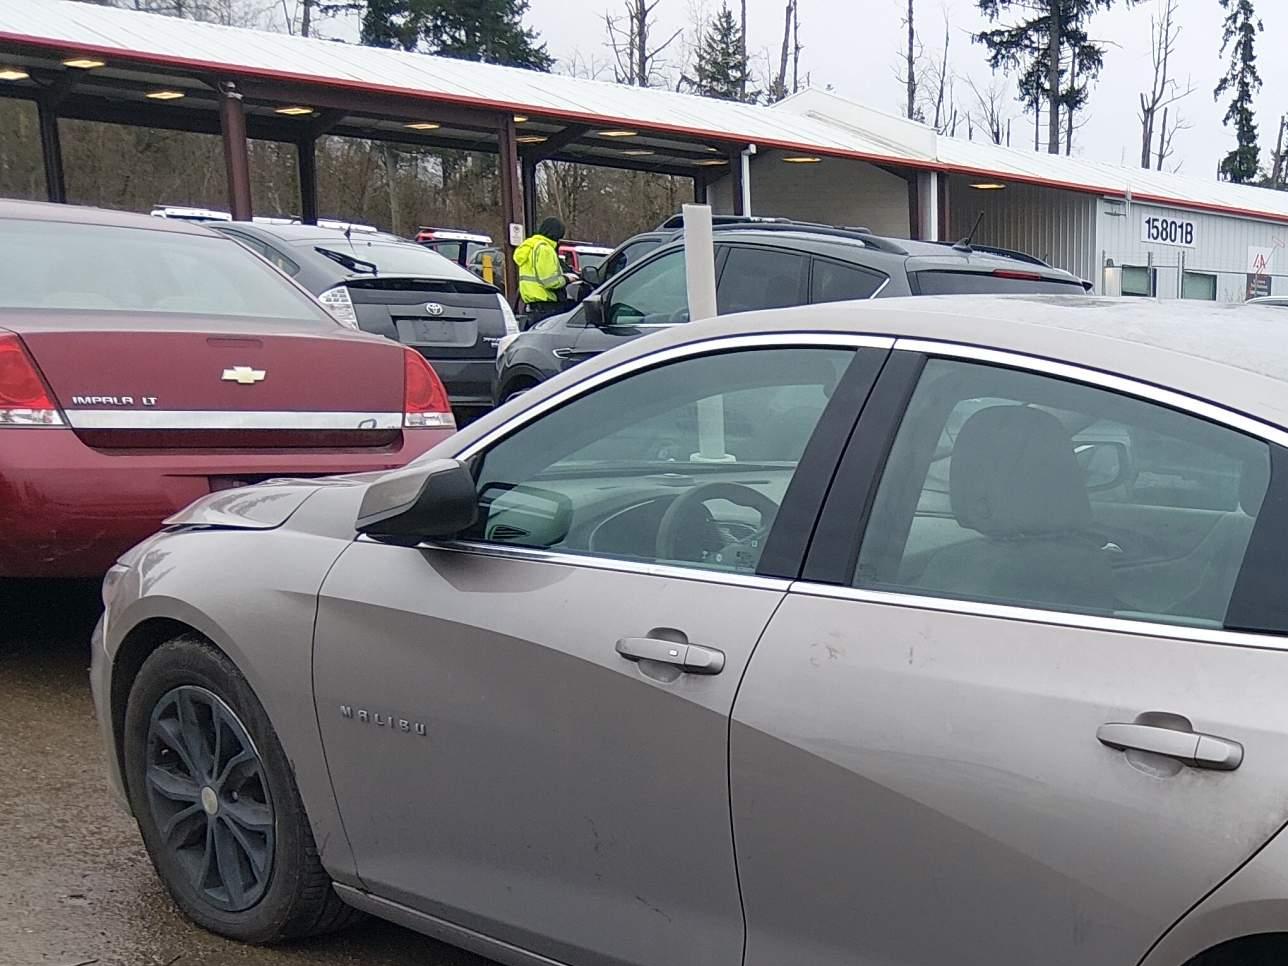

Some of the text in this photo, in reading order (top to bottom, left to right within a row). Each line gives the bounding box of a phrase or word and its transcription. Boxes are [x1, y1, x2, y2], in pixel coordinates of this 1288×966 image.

[1145, 216, 1194, 245] 15801B
[72, 395, 158, 406] IMPALA LT
[340, 705, 427, 737] MALIBU
